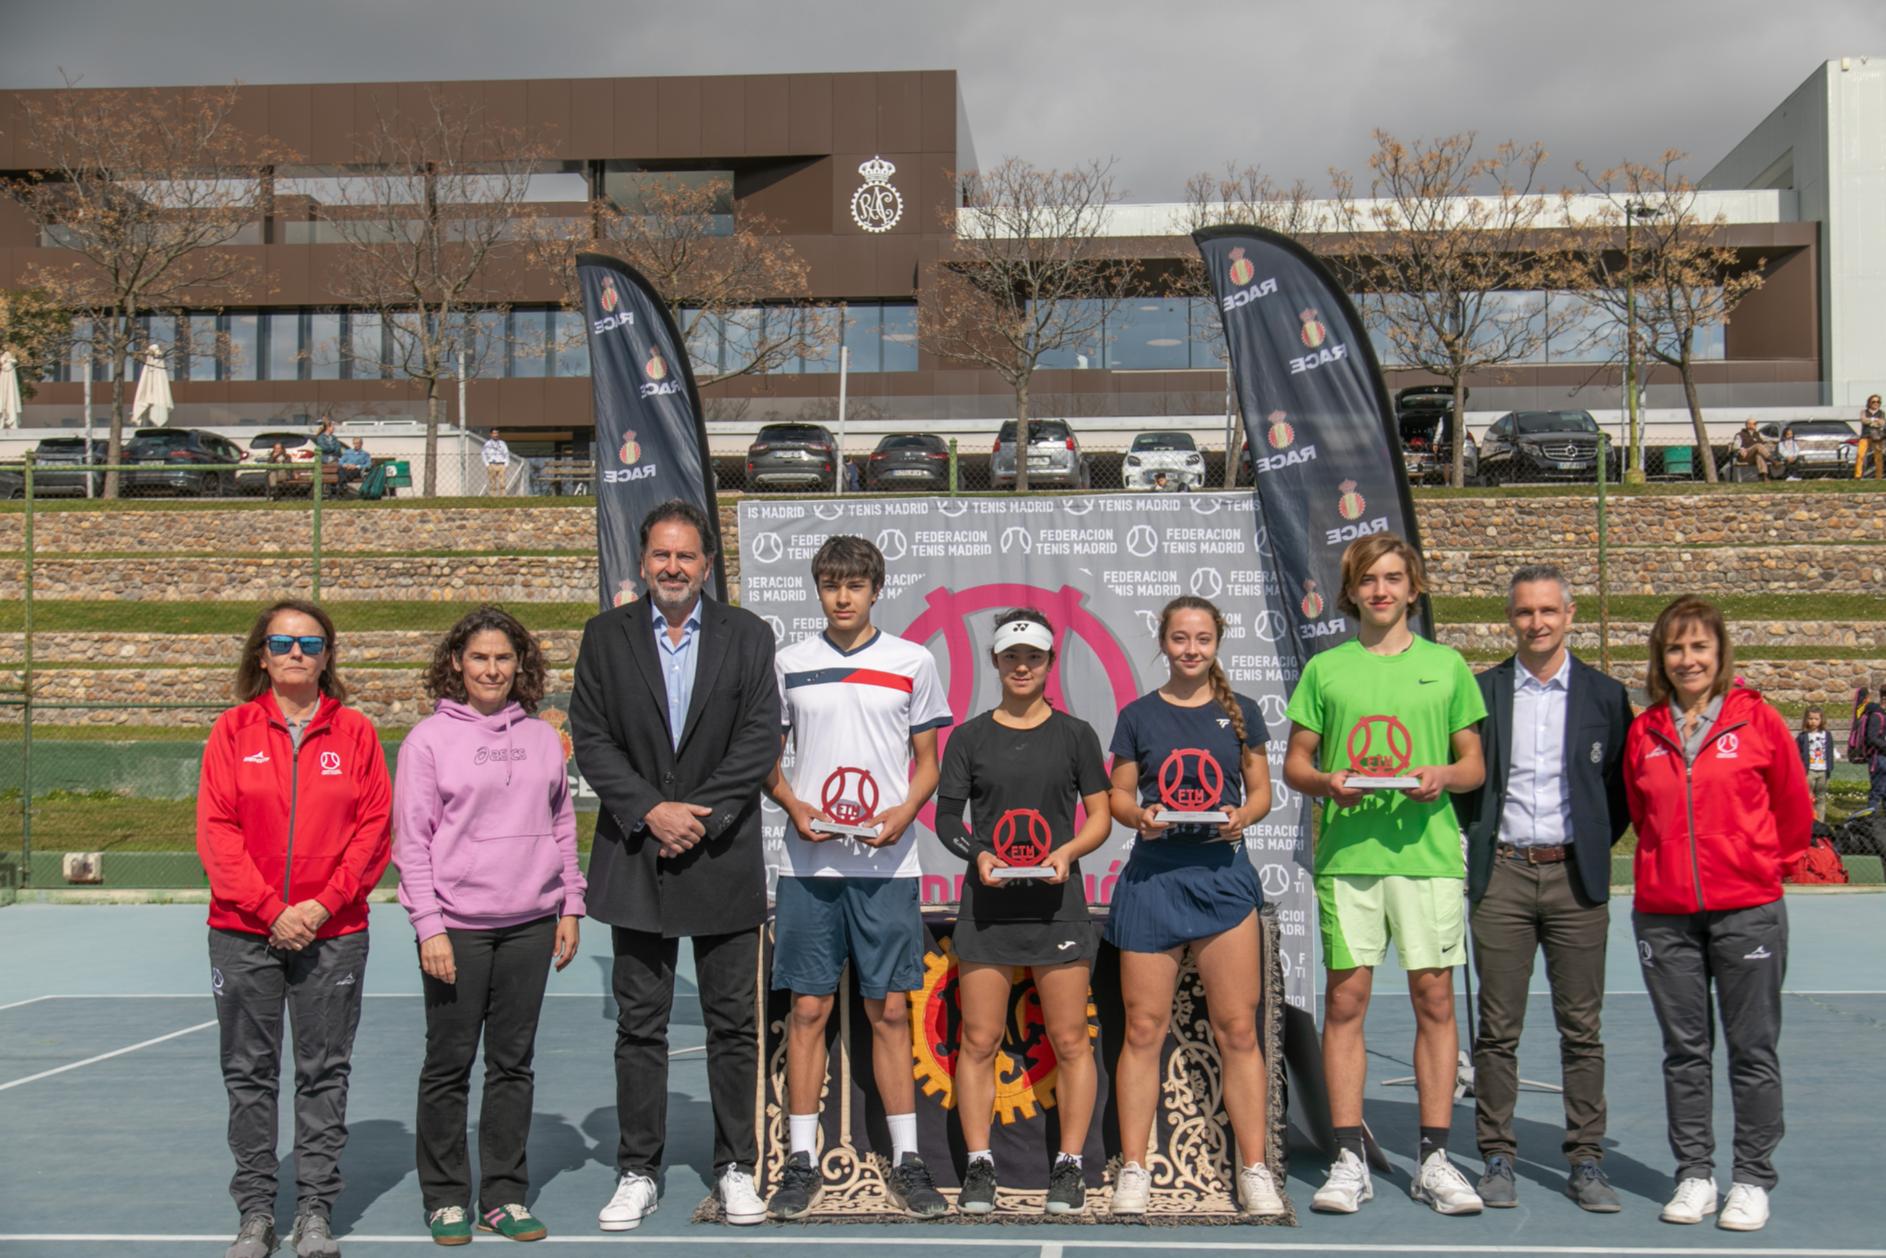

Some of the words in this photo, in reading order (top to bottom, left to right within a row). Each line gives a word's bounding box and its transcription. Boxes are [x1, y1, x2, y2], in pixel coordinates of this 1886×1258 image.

[849, 504, 882, 516] TENIS
[885, 502, 929, 515] MADRID
[972, 501, 1007, 514] TENIS
[1010, 500, 1054, 513] MADRID
[1098, 500, 1133, 512] TENIS
[1136, 499, 1181, 511] MADRID
[1227, 499, 1261, 512] TENIS
[762, 506, 805, 519] MADRID
[914, 530, 988, 543] FEDERACION
[1040, 529, 1114, 541] FEDERACION
[1166, 528, 1241, 541] FEDERACION
[911, 545, 945, 557] TENIS
[948, 544, 992, 556] MADRID
[1036, 543, 1071, 555] TENIS
[1073, 542, 1118, 555] MADRID
[1162, 542, 1197, 554] TENIS
[1200, 542, 1245, 554] MADRID
[1103, 570, 1178, 583] FEDERACION
[1231, 570, 1278, 583] FEDERA
[763, 589, 807, 602] MADRID
[1137, 584, 1182, 596] MADRID
[1227, 584, 1261, 596] TENIS
[1231, 655, 1298, 668] FEDERACIO
[1228, 669, 1262, 681] TENIS
[1265, 669, 1299, 681] MADR
